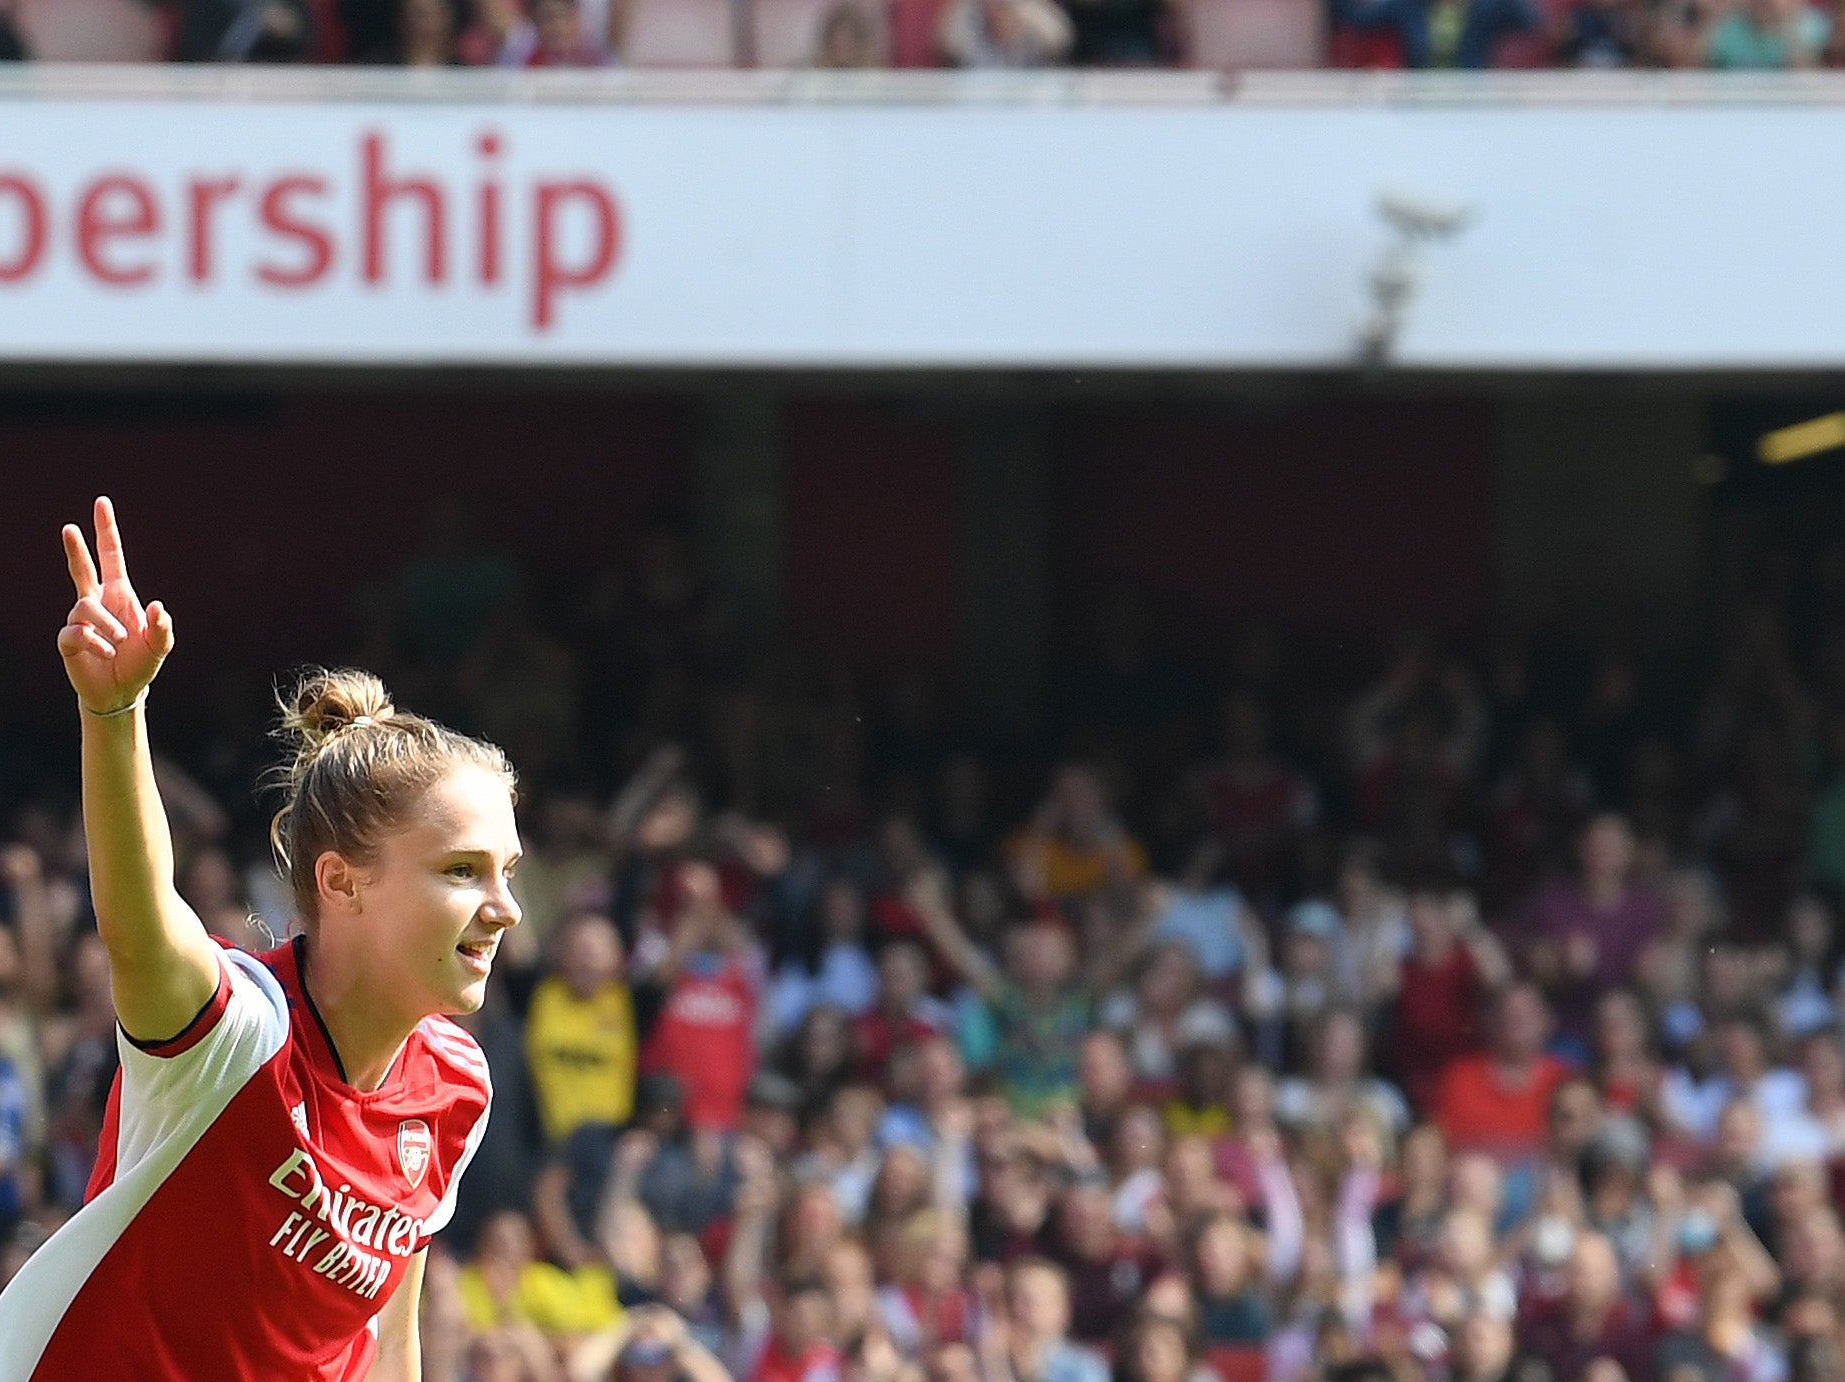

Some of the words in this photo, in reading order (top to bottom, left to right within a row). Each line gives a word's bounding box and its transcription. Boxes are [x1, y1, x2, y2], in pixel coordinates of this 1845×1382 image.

[269, 1147, 424, 1257] Emirates
[269, 1211, 330, 1262] FLY
[312, 1241, 392, 1299] BETTER
